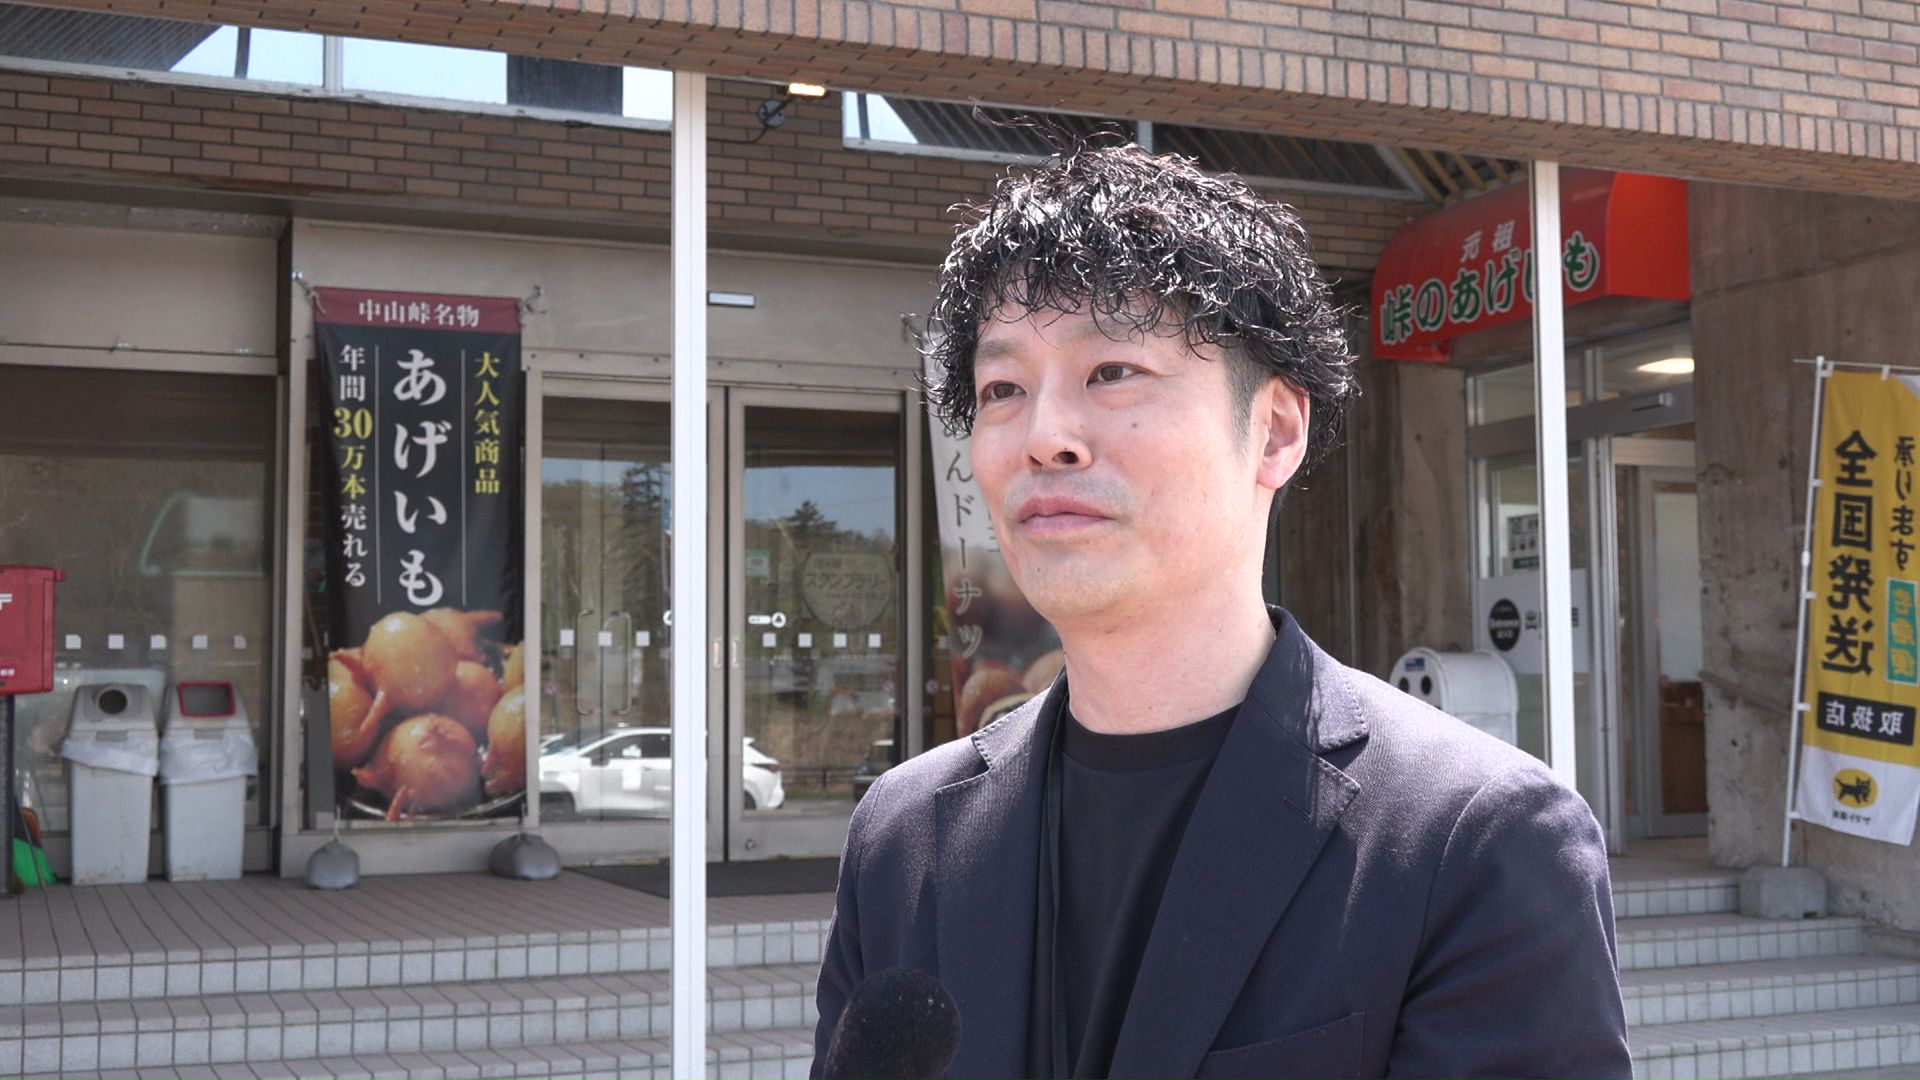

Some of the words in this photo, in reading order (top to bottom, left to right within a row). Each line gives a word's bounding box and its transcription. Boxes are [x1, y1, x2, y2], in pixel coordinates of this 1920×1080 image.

[1459, 219, 1516, 263] 元祖
[358, 299, 481, 328] 中山峠名物
[333, 344, 374, 587] 年間30万本売れる
[393, 349, 452, 606] あげいも
[474, 351, 500, 494] 大人気商品
